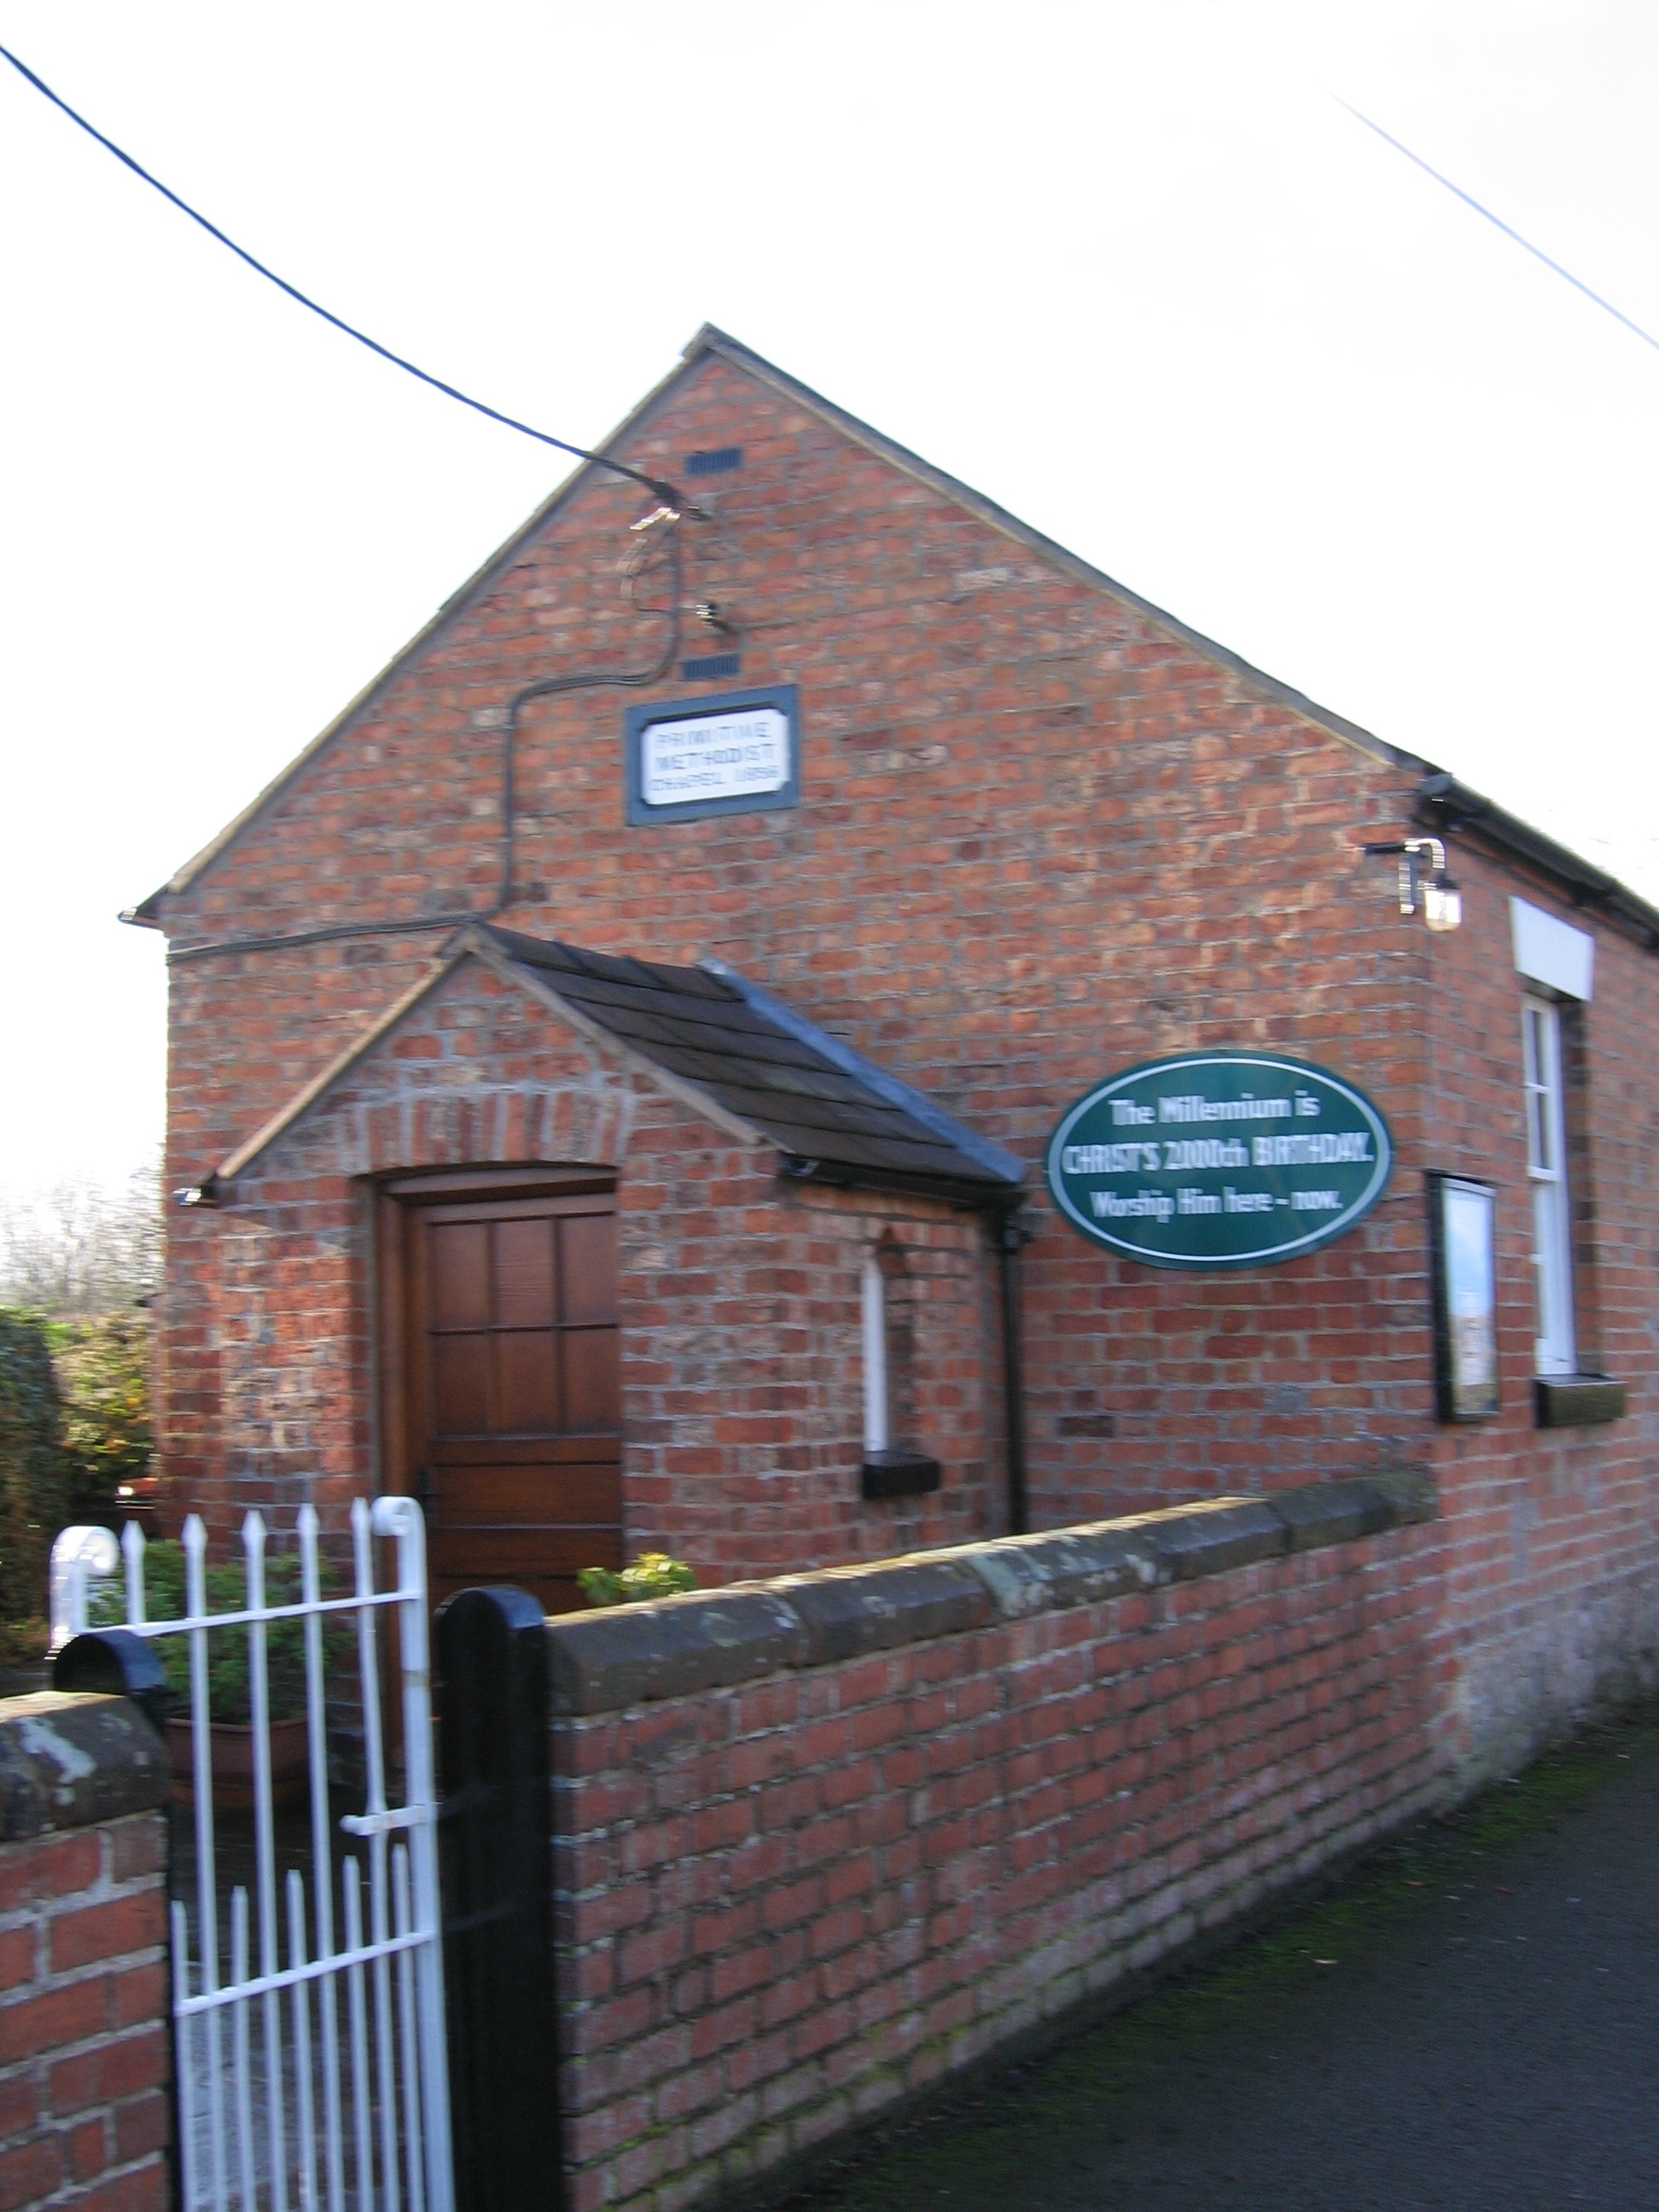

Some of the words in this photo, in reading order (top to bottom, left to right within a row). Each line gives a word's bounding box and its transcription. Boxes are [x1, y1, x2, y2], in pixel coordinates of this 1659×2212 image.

[655, 722, 771, 749] PRIMITIVE
[655, 743, 777, 771] METHODIST
[1109, 1099, 1155, 1126] The
[1158, 1092, 1291, 1123] Millennium
[1295, 1090, 1321, 1117] is
[1062, 1142, 1161, 1174] CHRIST'S
[1163, 1138, 1249, 1170] 2000th
[1090, 1190, 1176, 1224] Worship
[1177, 1187, 1221, 1214] Him
[1223, 1186, 1274, 1213] here
[1290, 1190, 1343, 1210] now.
